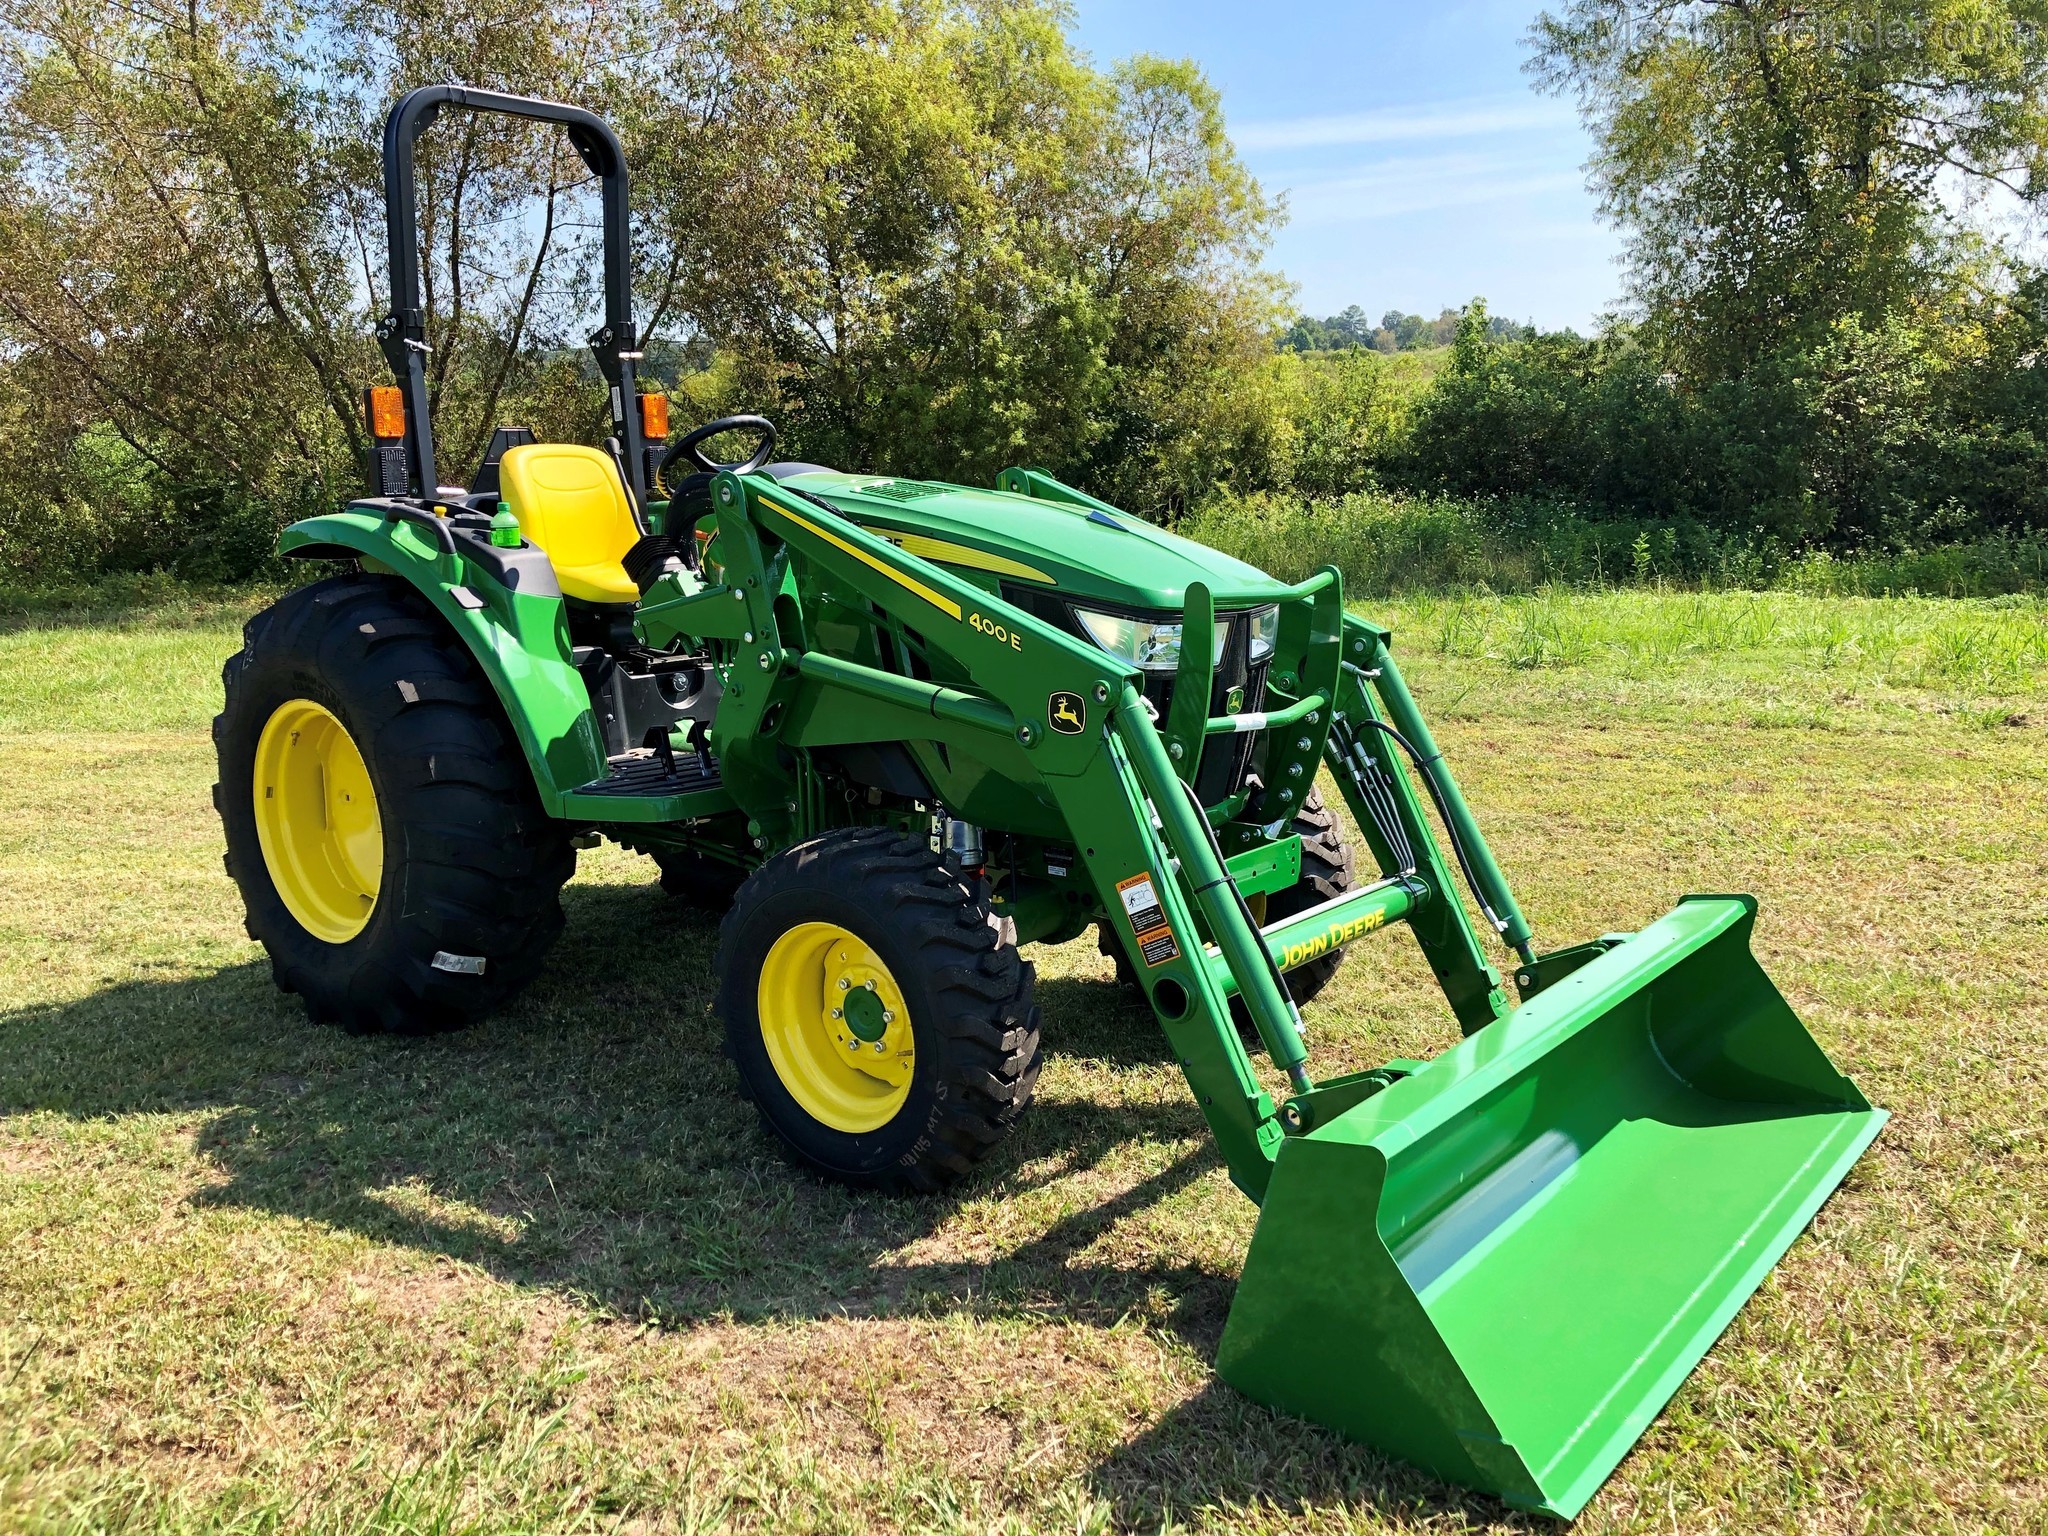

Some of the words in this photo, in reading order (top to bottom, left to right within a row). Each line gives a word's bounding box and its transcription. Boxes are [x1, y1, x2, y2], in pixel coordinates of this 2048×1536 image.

[968, 612, 1008, 643] 400
[1010, 632, 1022, 652] E
[1125, 875, 1146, 887] WARNING
[1147, 930, 1168, 941] WARNING
[1278, 933, 1328, 971] JOHN
[1328, 907, 1386, 949] DEERE
